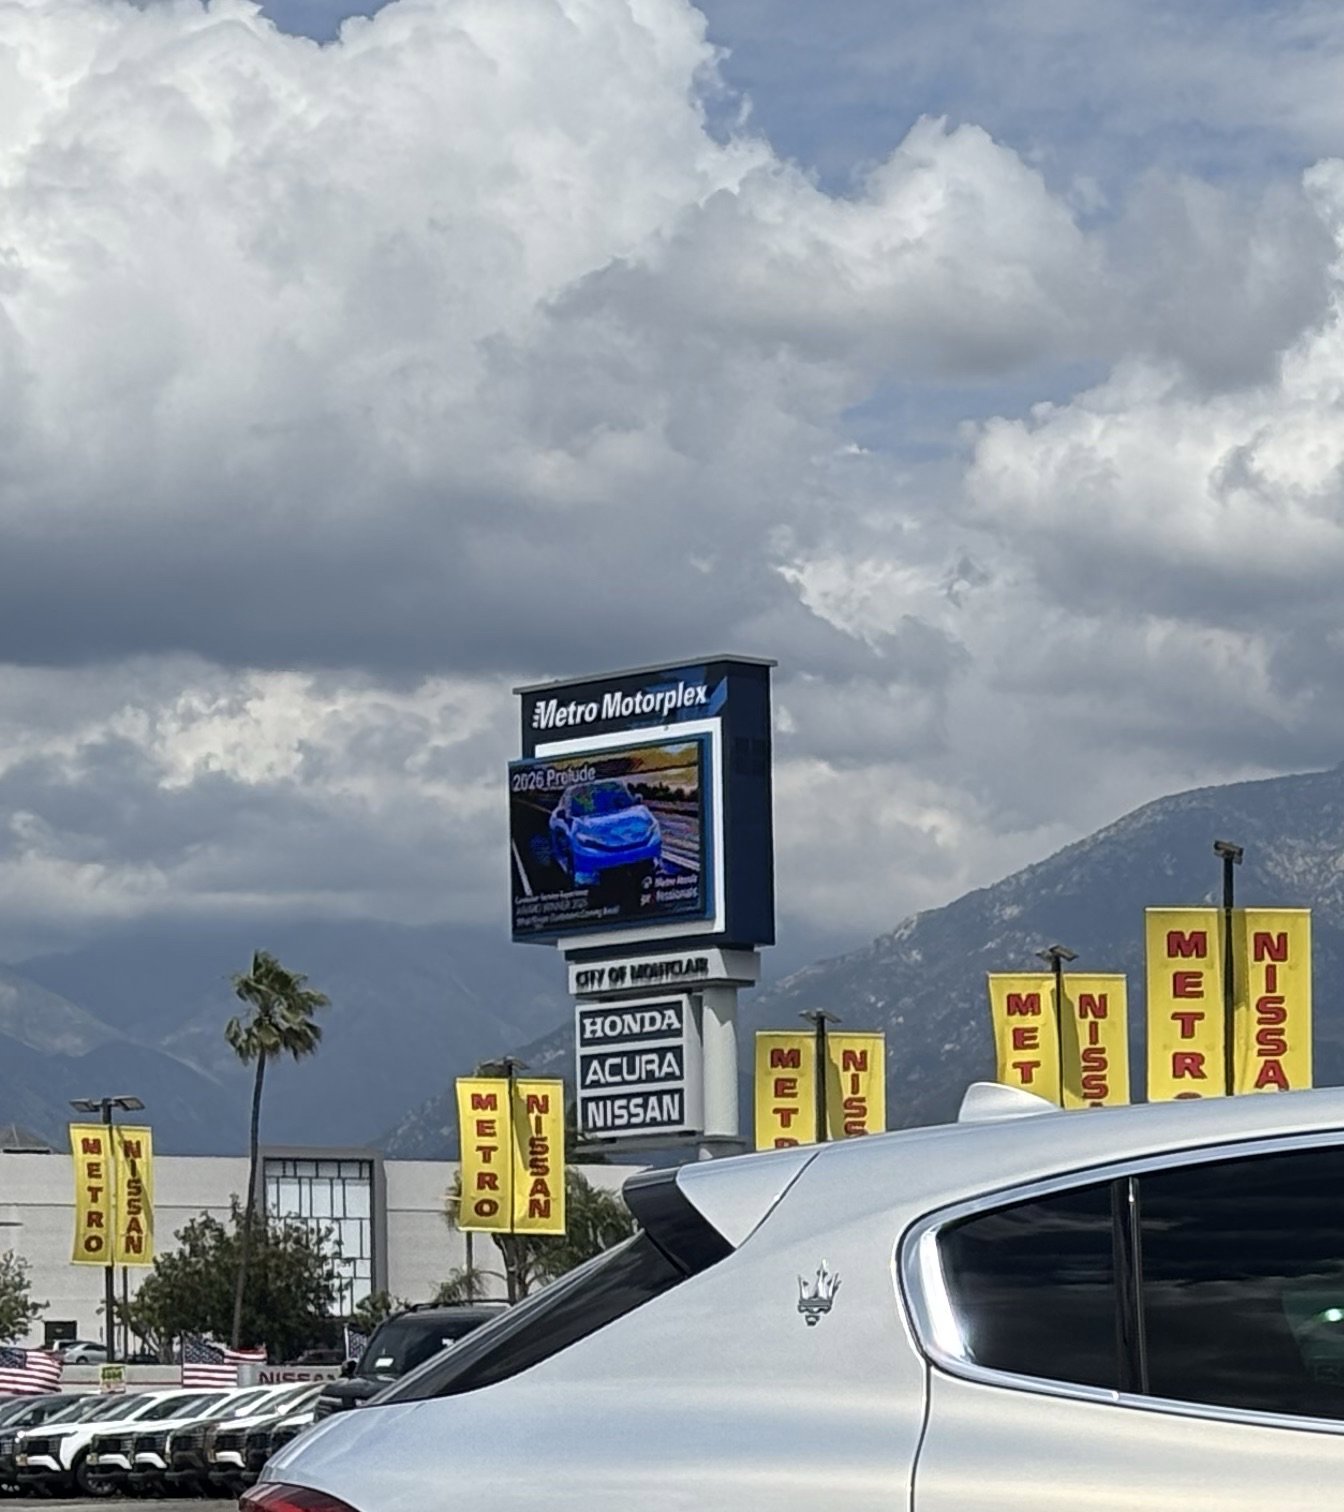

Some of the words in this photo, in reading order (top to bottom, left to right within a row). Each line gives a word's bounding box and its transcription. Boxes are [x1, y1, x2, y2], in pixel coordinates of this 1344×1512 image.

[533, 698, 598, 730] Metro
[601, 680, 708, 721] Motorplex
[512, 770, 545, 792] 2026
[576, 967, 605, 987] CITY
[608, 965, 627, 983] OF
[630, 957, 709, 980] MONTCLAIR
[583, 1009, 681, 1039] HONDA
[585, 1052, 681, 1085] ACURA
[1078, 993, 1109, 1107] NISS
[588, 1093, 680, 1128] NISSAN
[470, 1093, 499, 1217] METRO
[526, 1094, 551, 1218] NISSAN
[81, 1137, 104, 1252] METRO
[123, 1140, 143, 1254] NISSAN
